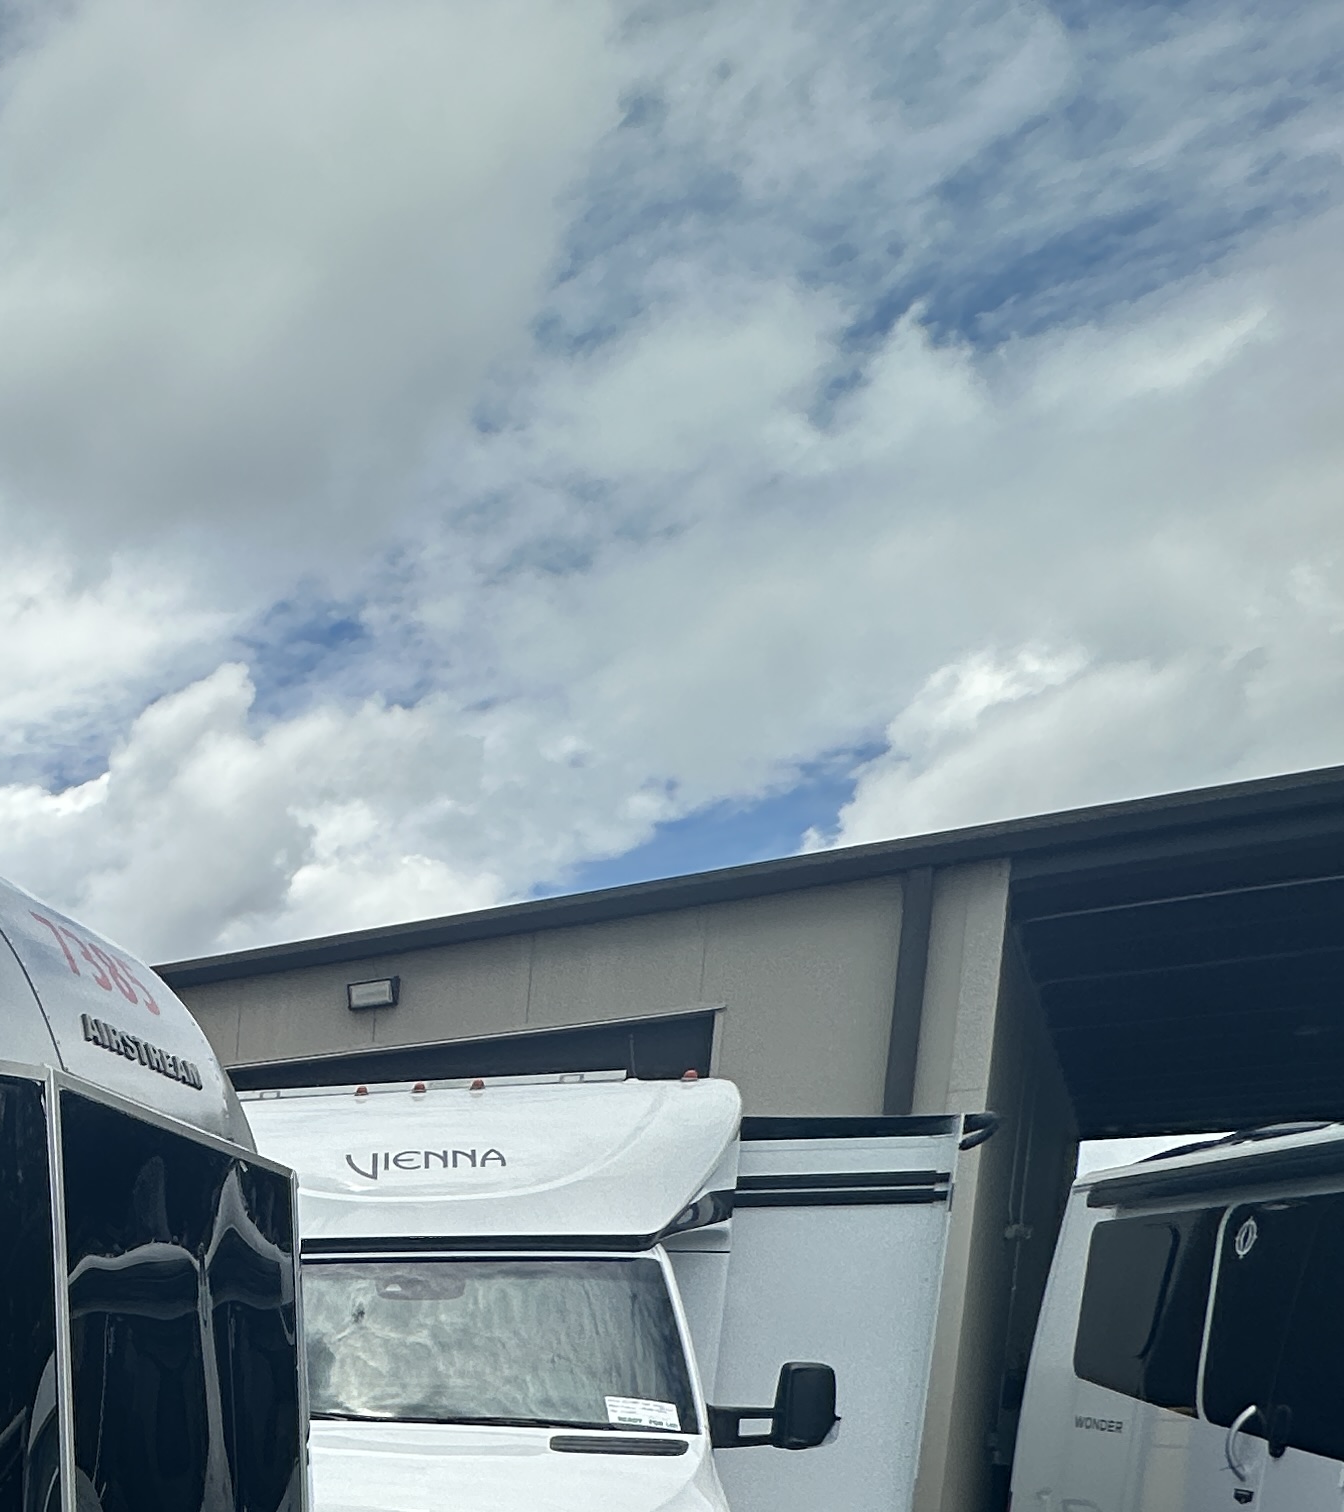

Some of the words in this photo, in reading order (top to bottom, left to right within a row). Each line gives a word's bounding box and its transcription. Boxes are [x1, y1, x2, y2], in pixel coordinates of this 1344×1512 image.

[28, 909, 161, 1016] 7385
[79, 1012, 204, 1092] AIRSTREAM
[345, 1148, 507, 1180] VIENNA
[1075, 1415, 1123, 1434] WONDER
